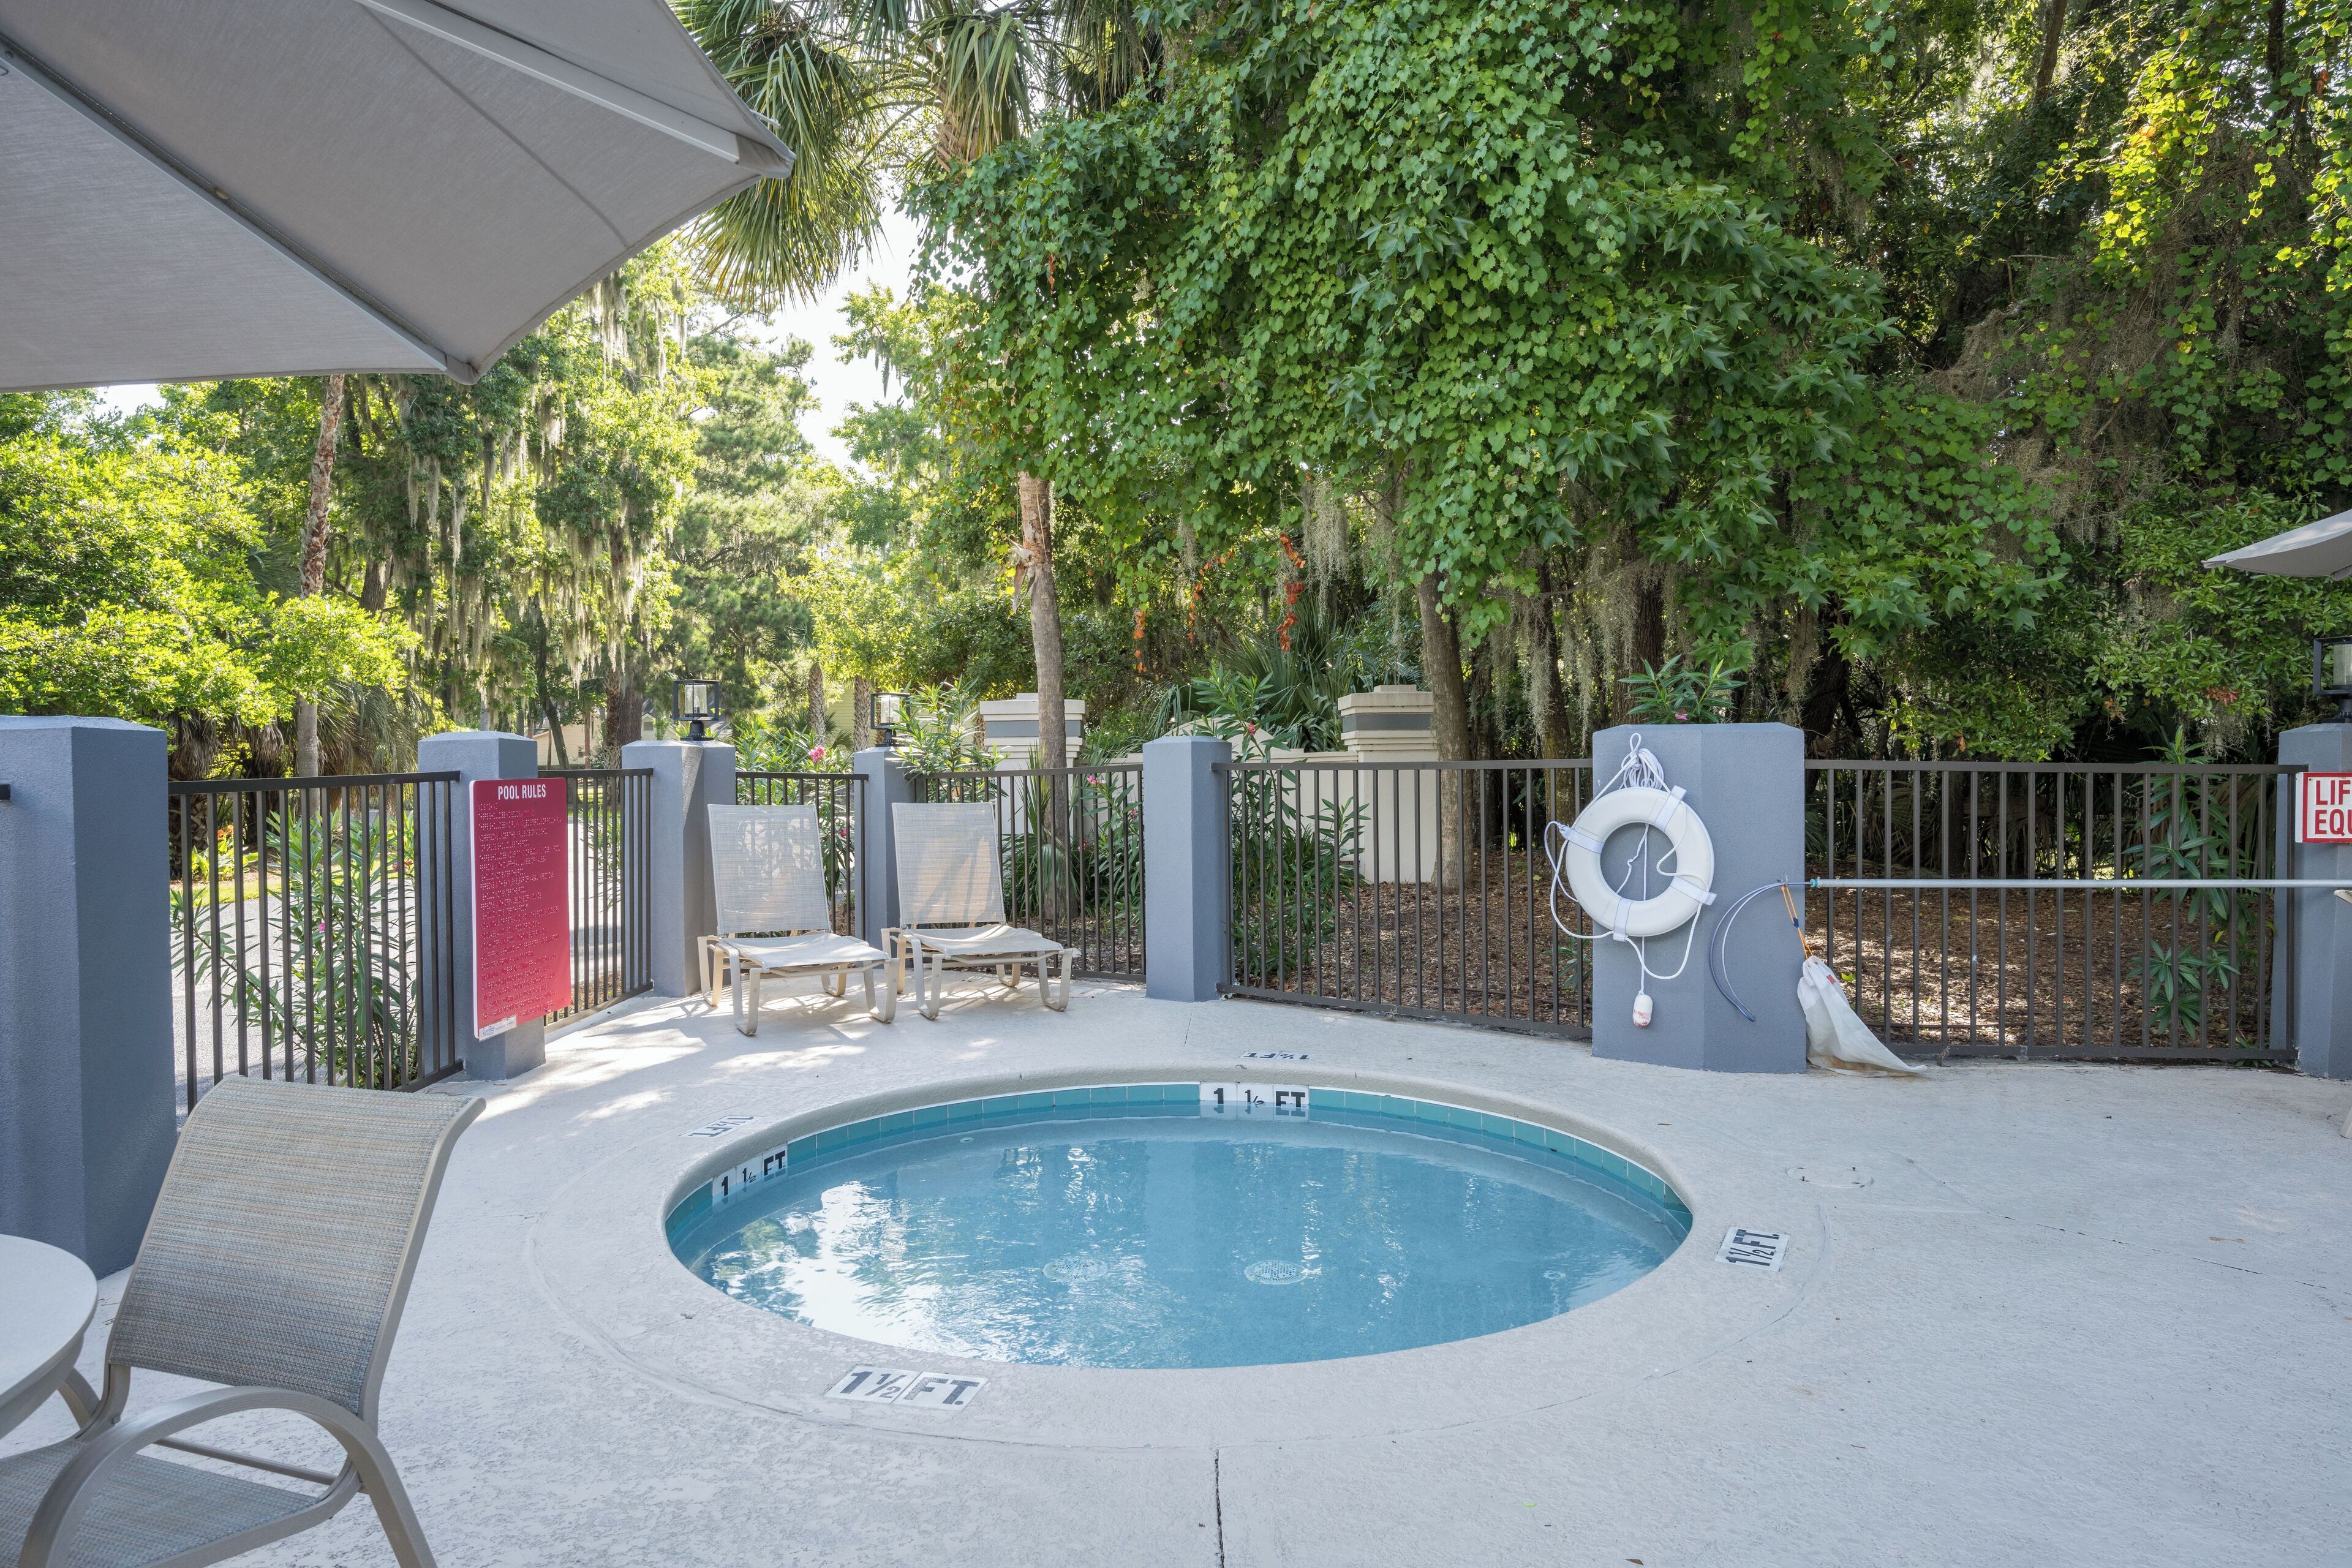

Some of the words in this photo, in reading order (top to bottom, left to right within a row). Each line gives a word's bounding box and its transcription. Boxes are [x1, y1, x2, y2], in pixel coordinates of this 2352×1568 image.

[498, 786, 519, 800] POOL
[522, 784, 546, 798] RULES
[1213, 1088, 1224, 1104] 1
[721, 1175, 728, 1196] 1
[903, 1376, 980, 1405] FT.
